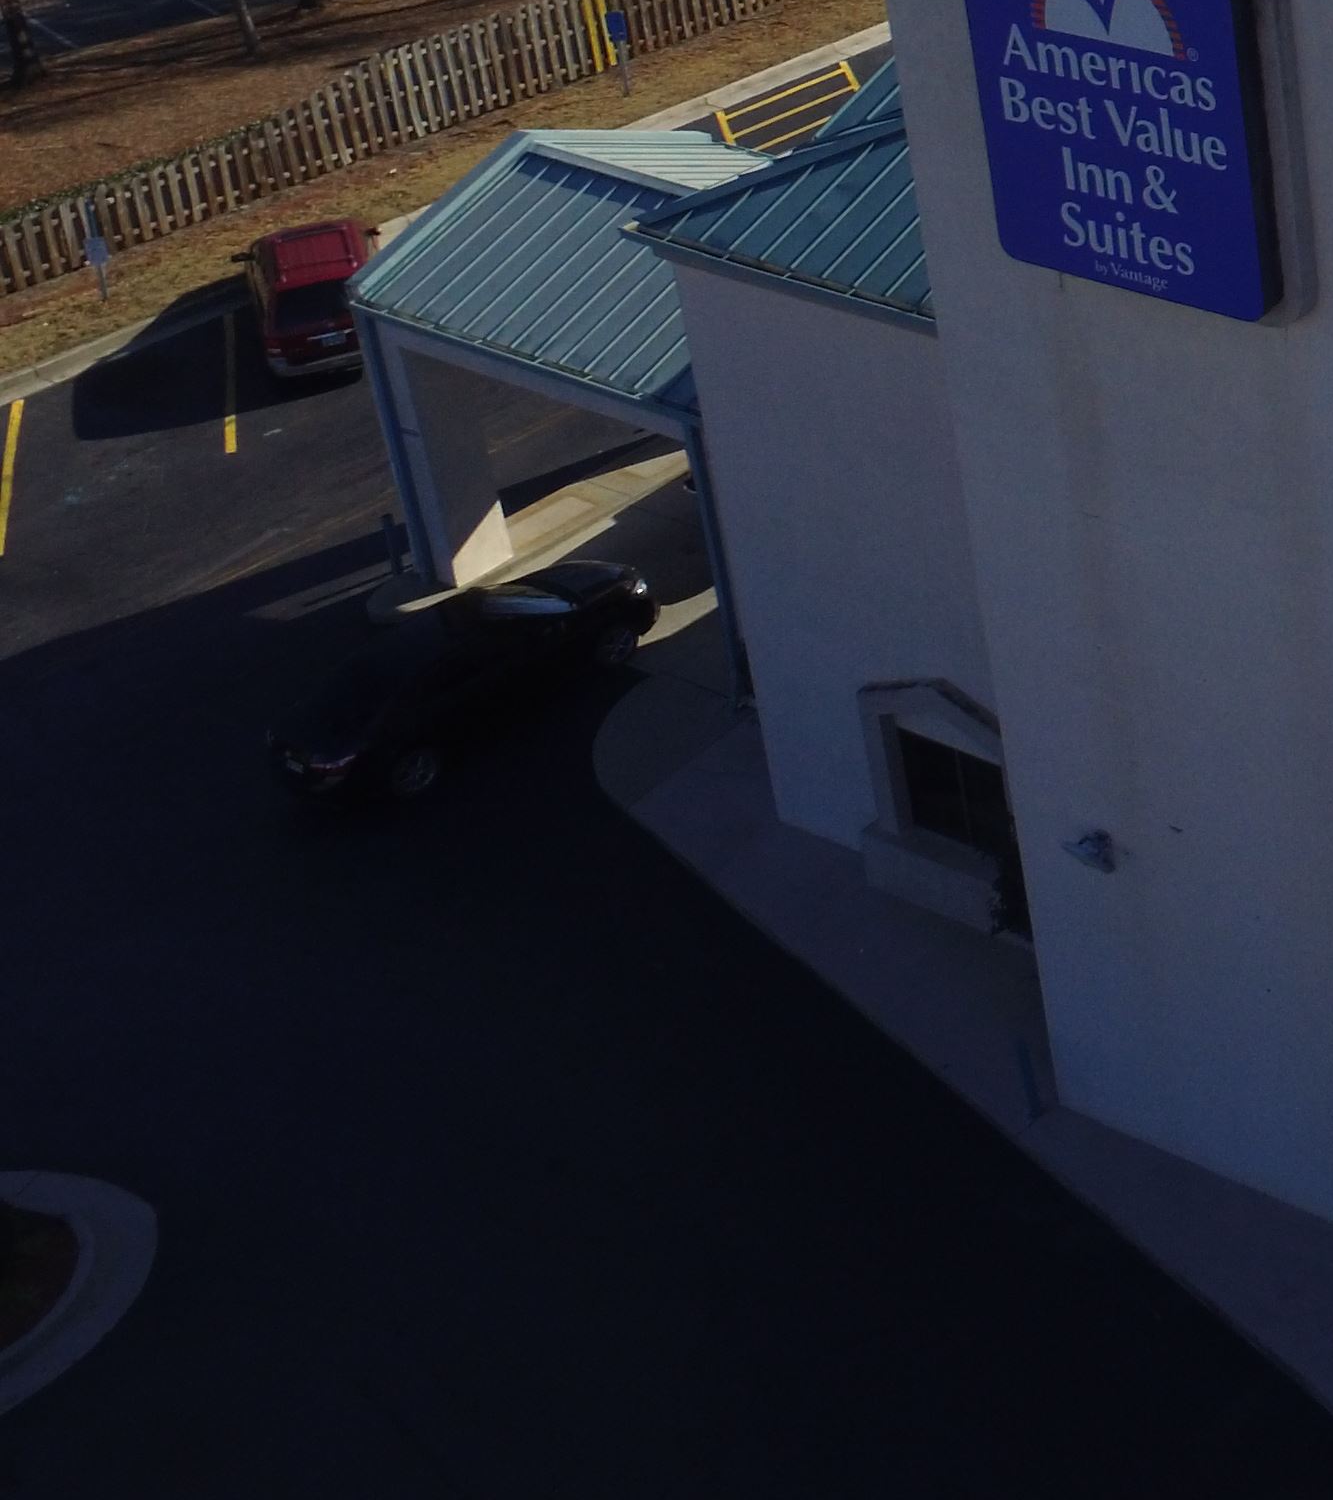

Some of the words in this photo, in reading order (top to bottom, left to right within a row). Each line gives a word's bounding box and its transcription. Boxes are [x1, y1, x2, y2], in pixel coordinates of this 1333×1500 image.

[1003, 23, 1216, 111] Americas
[1000, 76, 1096, 141] Best
[1104, 100, 1228, 171] Value
[1062, 147, 1133, 204] Inn
[1143, 164, 1178, 214] &
[1061, 202, 1195, 276] Suites
[1095, 260, 1108, 276] by
[1110, 262, 1169, 291] Vantage
